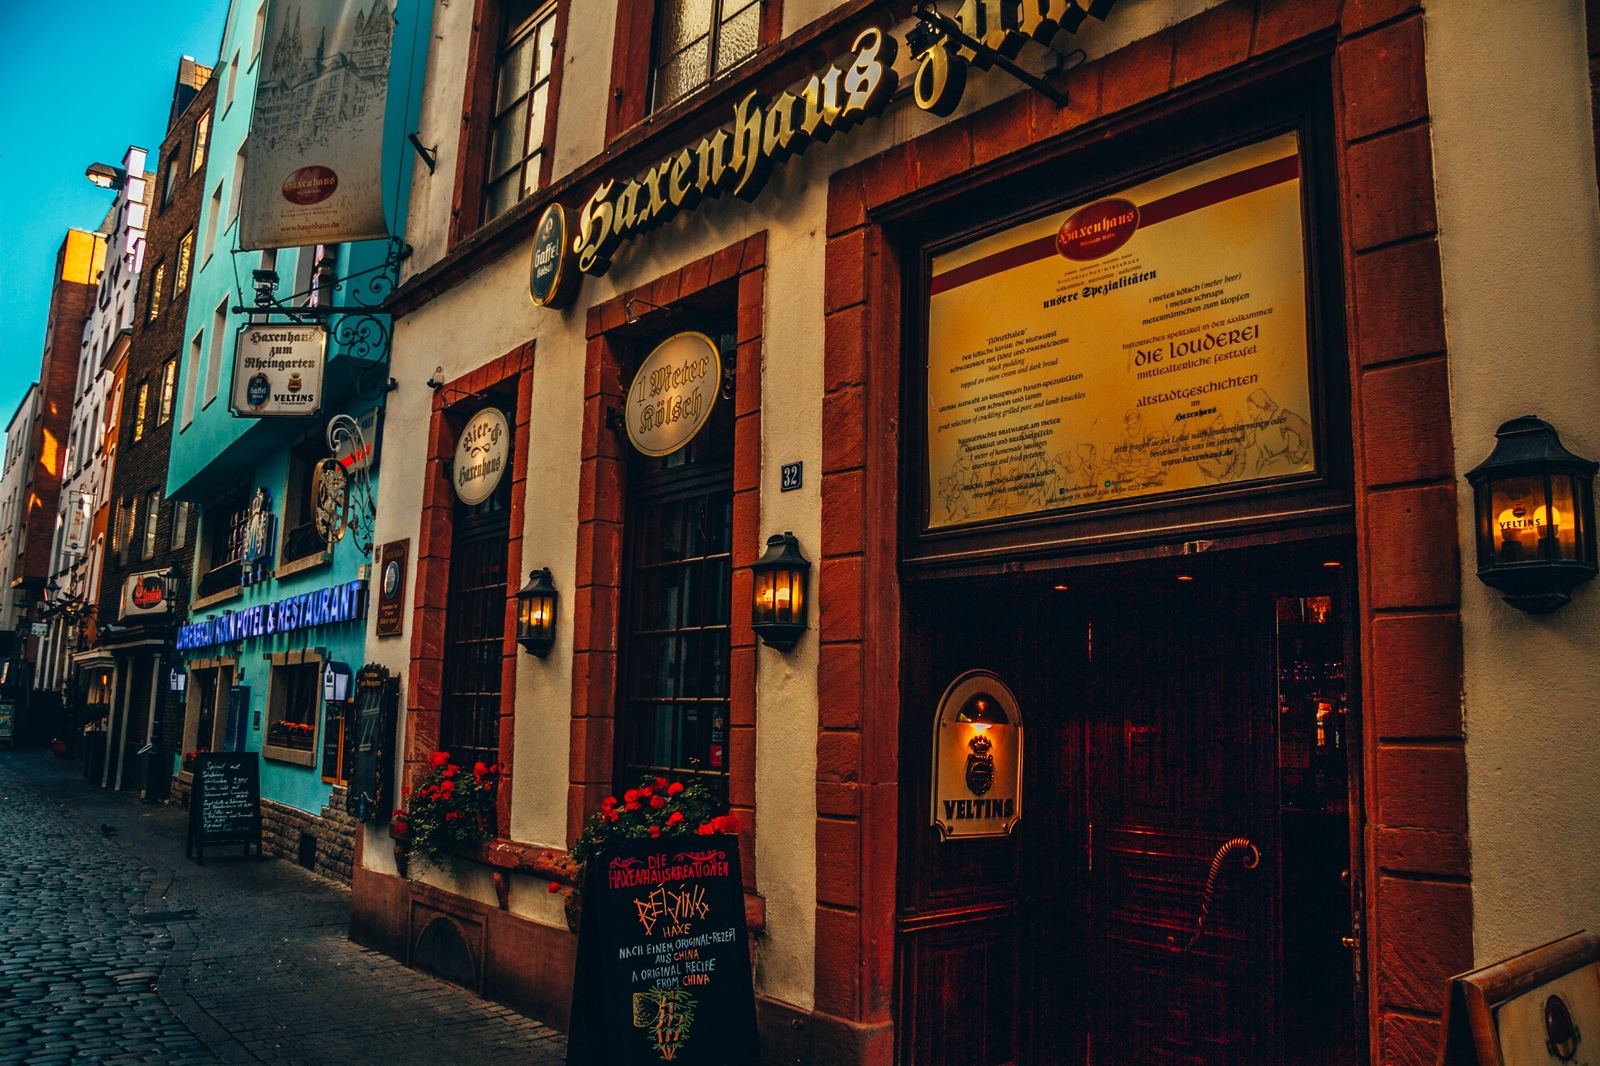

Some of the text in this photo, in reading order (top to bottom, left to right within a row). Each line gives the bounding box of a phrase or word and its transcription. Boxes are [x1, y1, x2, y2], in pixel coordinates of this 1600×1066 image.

[573, 27, 882, 272] Haxenhaus
[280, 221, 340, 232] www.haxenhaus.de
[1059, 211, 1135, 245] Haxenhaus
[534, 239, 560, 268] Gaffel
[1043, 270, 1156, 308] unsere Spezialitäten
[1152, 291, 1175, 302] meter
[1176, 284, 1200, 296] kölsch
[1200, 278, 1223, 289] (meter
[1224, 272, 1242, 283] beer)
[1169, 297, 1192, 308] meter
[1193, 289, 1224, 302] schnaps
[1202, 300, 1219, 310] zum
[1220, 292, 1250, 305] klopfen
[1121, 334, 1165, 349] historisches
[1166, 325, 1200, 340] spektakel
[1210, 319, 1225, 328] der
[1226, 307, 1273, 324] saalkammer
[251, 331, 315, 345] Haxenhaus
[269, 346, 293, 357] zum
[1013, 348, 1025, 356] und
[244, 357, 316, 371] Rheingarten
[988, 358, 1025, 372] black pudding
[960, 378, 977, 389] topped
[984, 374, 1000, 382] onion
[1000, 369, 1017, 378] cream
[1017, 365, 1028, 374] and
[1028, 362, 1041, 371] dark
[1042, 357, 1058, 368] bread
[274, 394, 314, 402] VELTINS
[1011, 395, 1024, 404] und
[639, 387, 702, 434] Kölsch
[937, 422, 950, 433] great
[950, 418, 971, 428] selection
[971, 414, 978, 424] of
[977, 411, 1001, 421] crackling
[1001, 405, 1020, 418] grilled
[1033, 399, 1044, 409] and
[1044, 396, 1060, 406] lamb
[1060, 391, 1086, 402] knuckles
[1174, 407, 1216, 421] Haxenhaus
[1040, 417, 1061, 426] meter
[1270, 415, 1287, 425] oder
[995, 437, 1008, 446] und
[1180, 444, 1190, 452] sie
[988, 448, 995, 459] of
[994, 444, 1022, 455] homemade
[998, 456, 1009, 465] and
[1009, 452, 1023, 464] fried
[1161, 447, 1233, 466] www.haxenhaus.de
[459, 452, 501, 490] Haxenhaus
[784, 465, 798, 487] 32
[1499, 518, 1541, 530] VELTINS
[236, 604, 264, 639] HOTEL
[266, 602, 275, 634] &
[276, 580, 362, 632] RESTAURANT
[943, 798, 1014, 820] VELTINS
[647, 853, 667, 869] DIE
[608, 861, 729, 889] HAXENHAUSKREATIONEN
[663, 923, 692, 938] HAXE
[619, 928, 736, 959] NACH EINEM ORIGINAL-REZEPT
[655, 948, 700, 964] AUS CHINA
[631, 958, 717, 982] A ORIGINAL RECIPE
[656, 973, 711, 989] FROM CHINA
